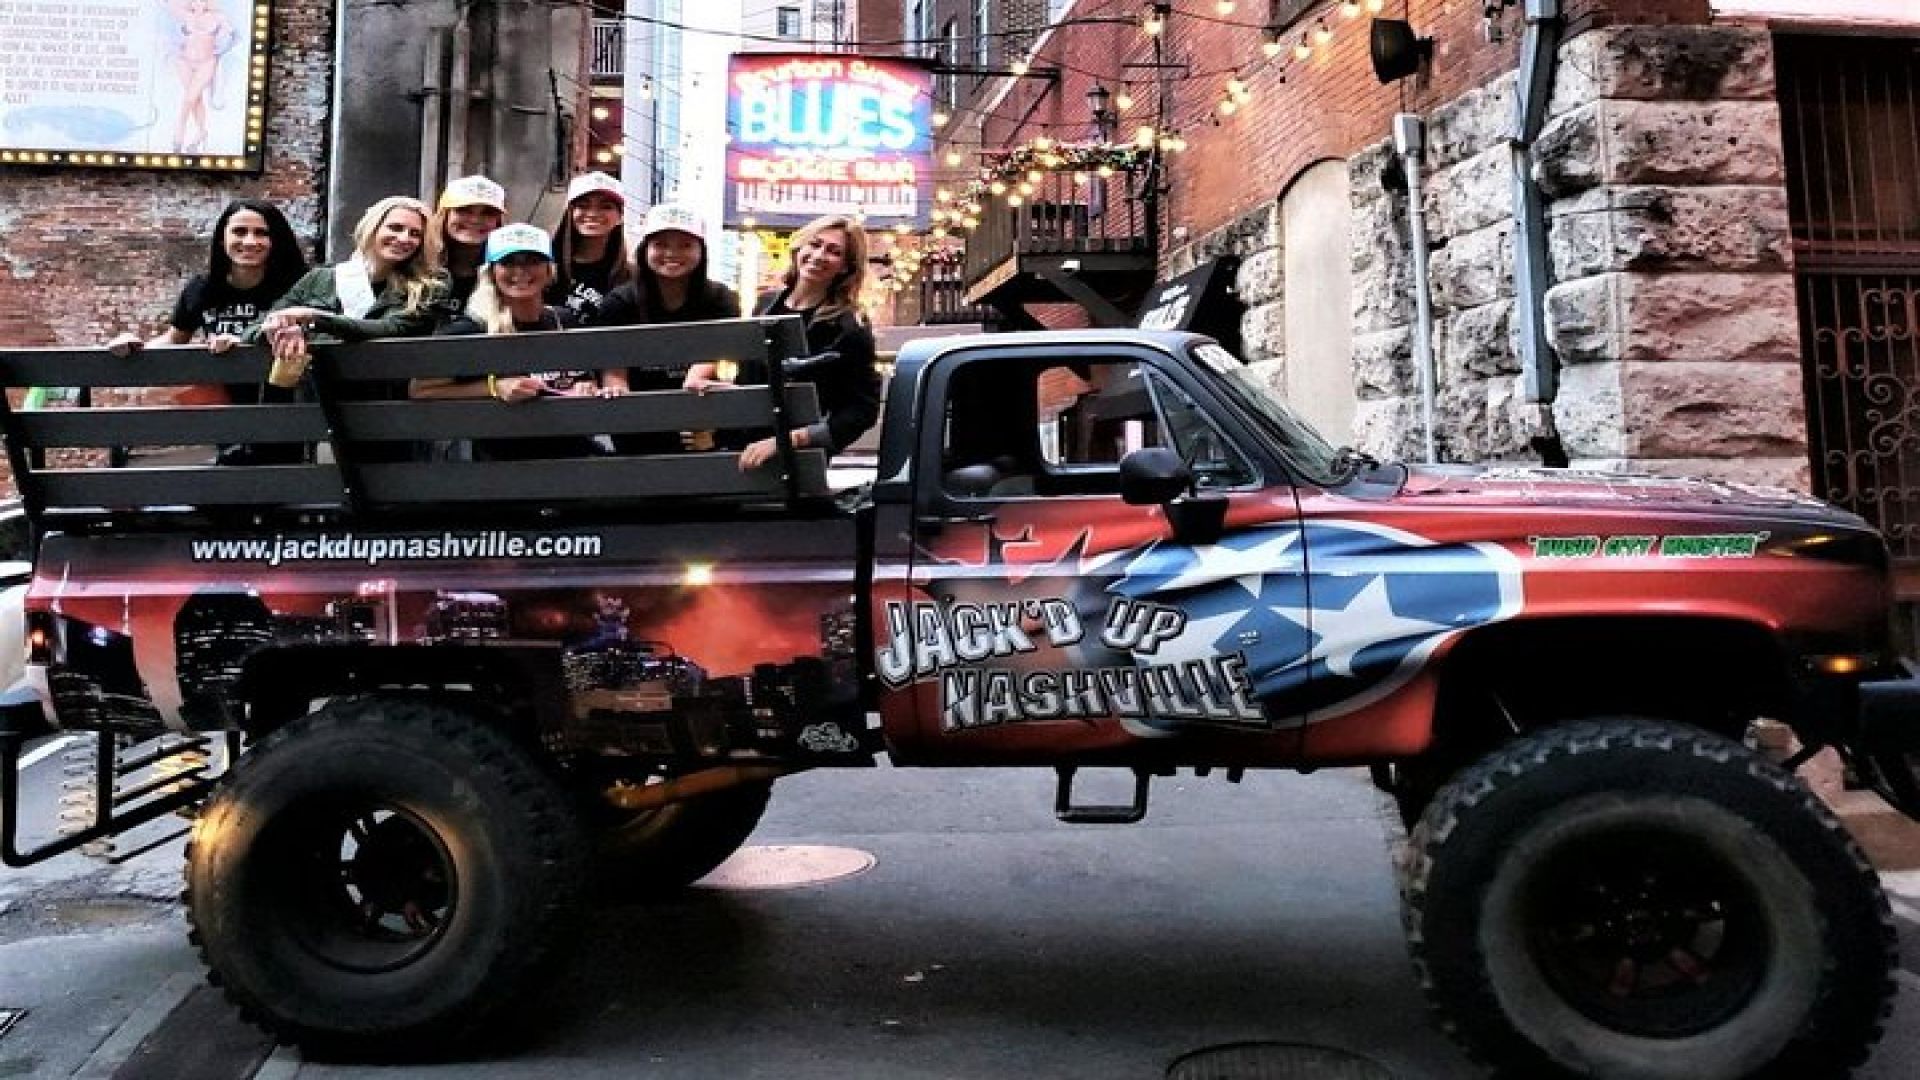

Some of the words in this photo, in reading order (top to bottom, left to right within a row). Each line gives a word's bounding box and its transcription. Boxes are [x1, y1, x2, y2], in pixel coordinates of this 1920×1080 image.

[739, 82, 916, 149] BLUES
[192, 532, 601, 565] www.jackdupnashville.com
[1602, 535, 1658, 558] CITY
[878, 597, 1085, 688] JACK'D
[1100, 599, 1187, 655] UP
[942, 650, 1269, 732] NASHVILLE
